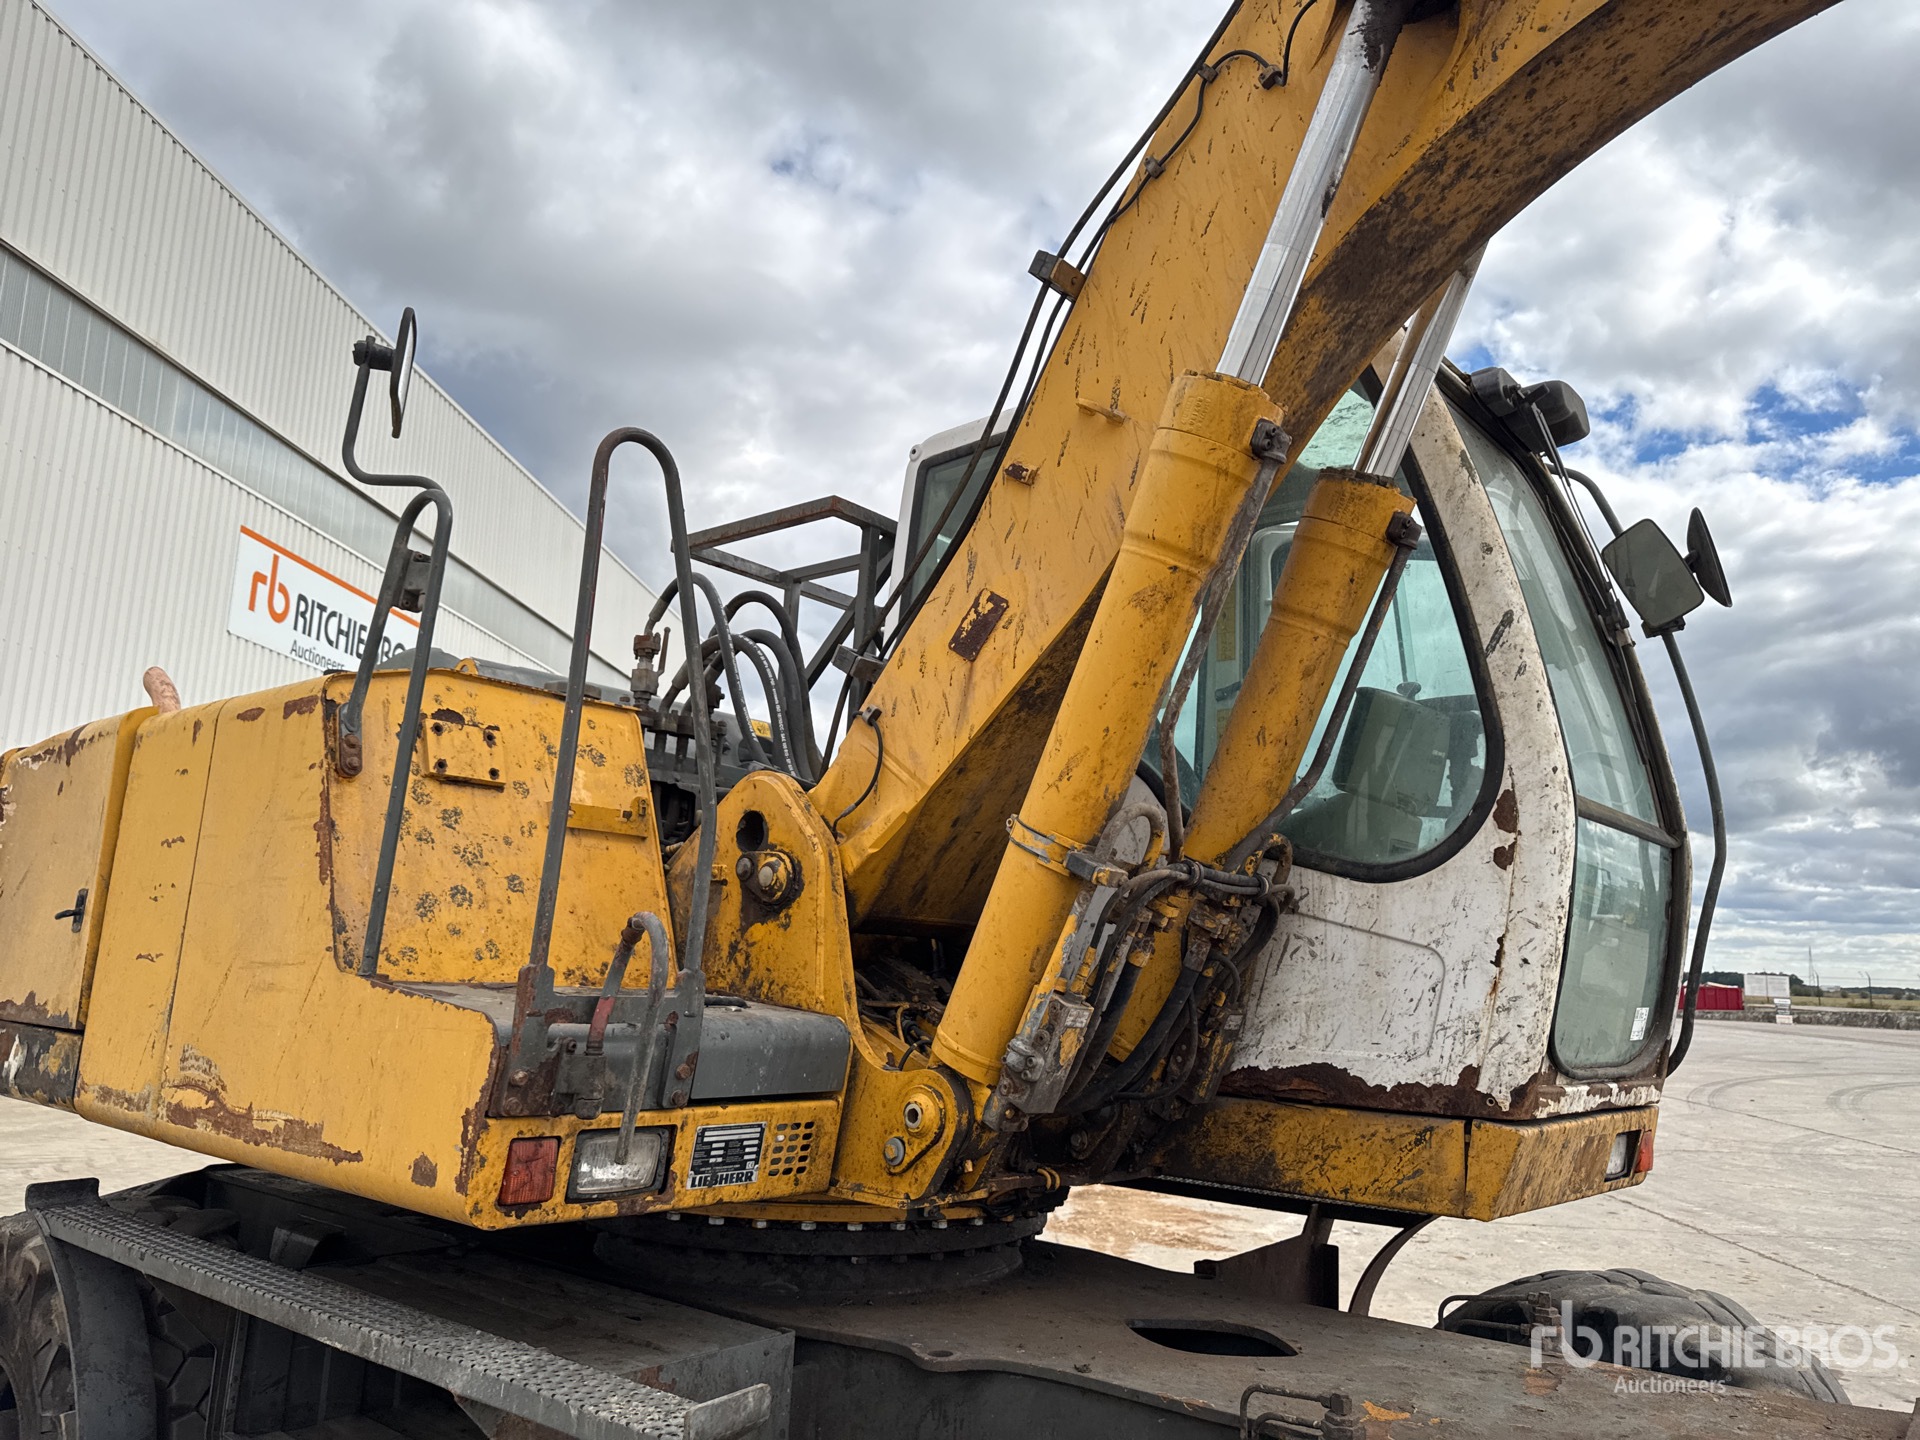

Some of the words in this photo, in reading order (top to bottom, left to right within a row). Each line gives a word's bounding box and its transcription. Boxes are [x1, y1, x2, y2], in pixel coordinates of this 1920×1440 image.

[248, 553, 291, 624] rb
[290, 639, 345, 669] Auctioneer
[293, 593, 368, 660] RITCHIE
